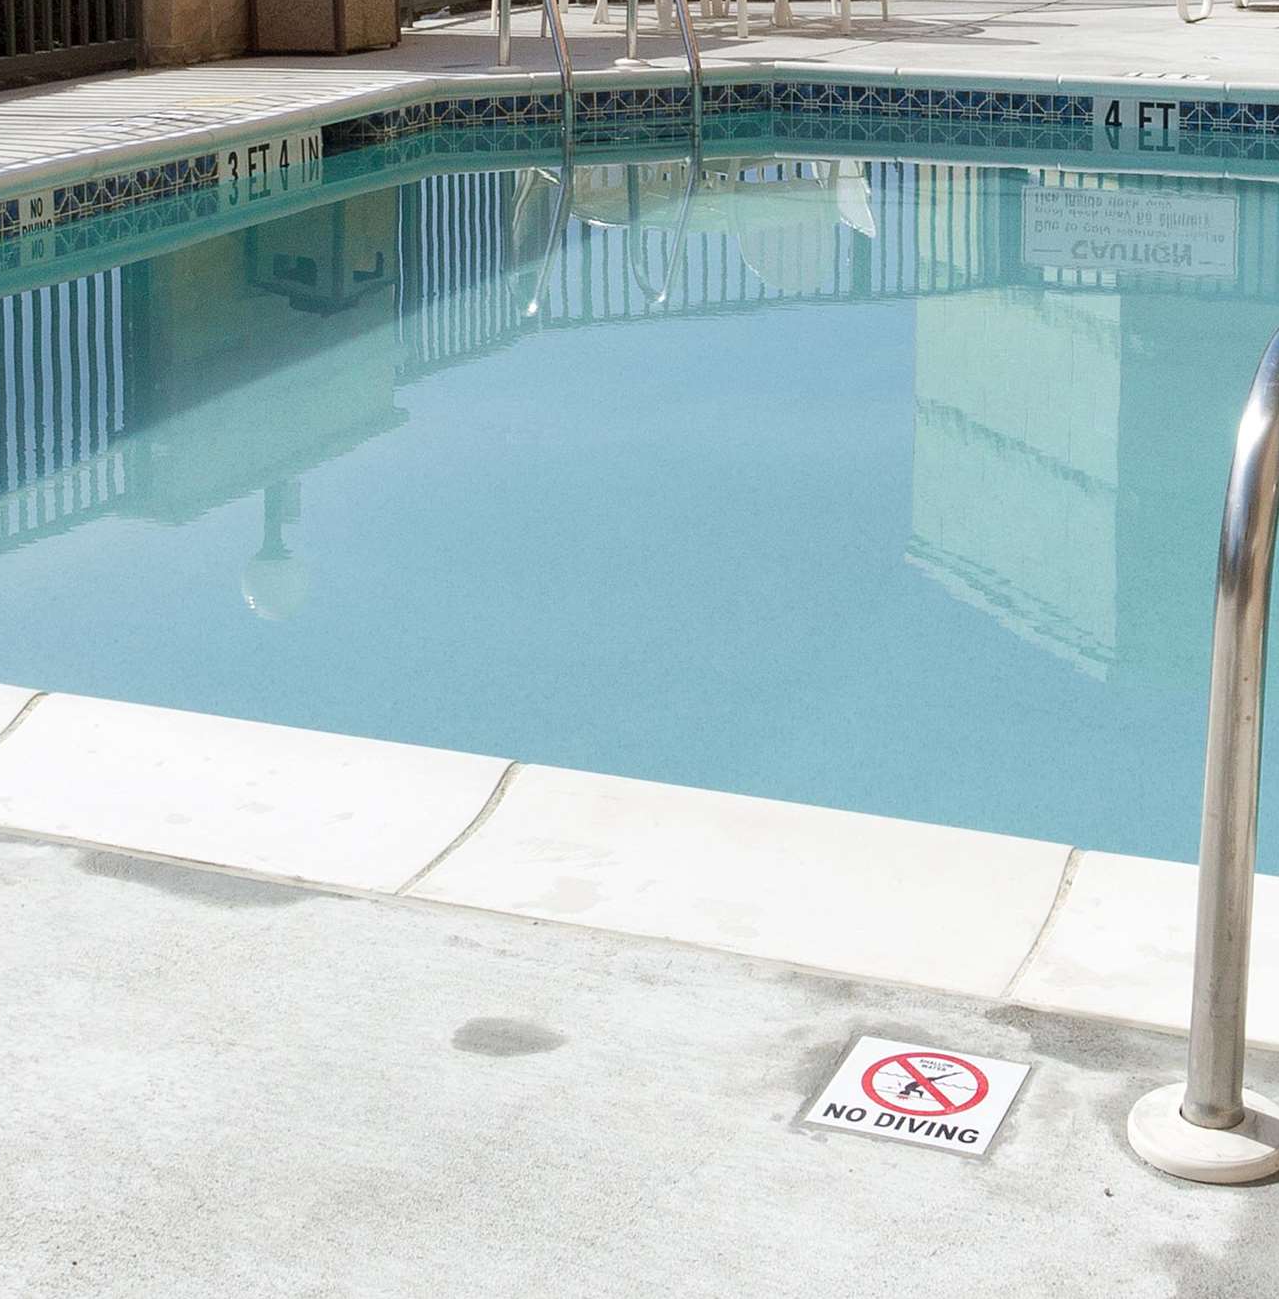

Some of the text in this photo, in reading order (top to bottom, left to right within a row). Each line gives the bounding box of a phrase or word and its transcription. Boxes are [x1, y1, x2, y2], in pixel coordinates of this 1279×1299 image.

[1104, 99, 1176, 130] 4 FT
[228, 135, 319, 181] 3 FT 4 IN
[30, 197, 44, 219] NO
[822, 1102, 980, 1144] NO DIVING
